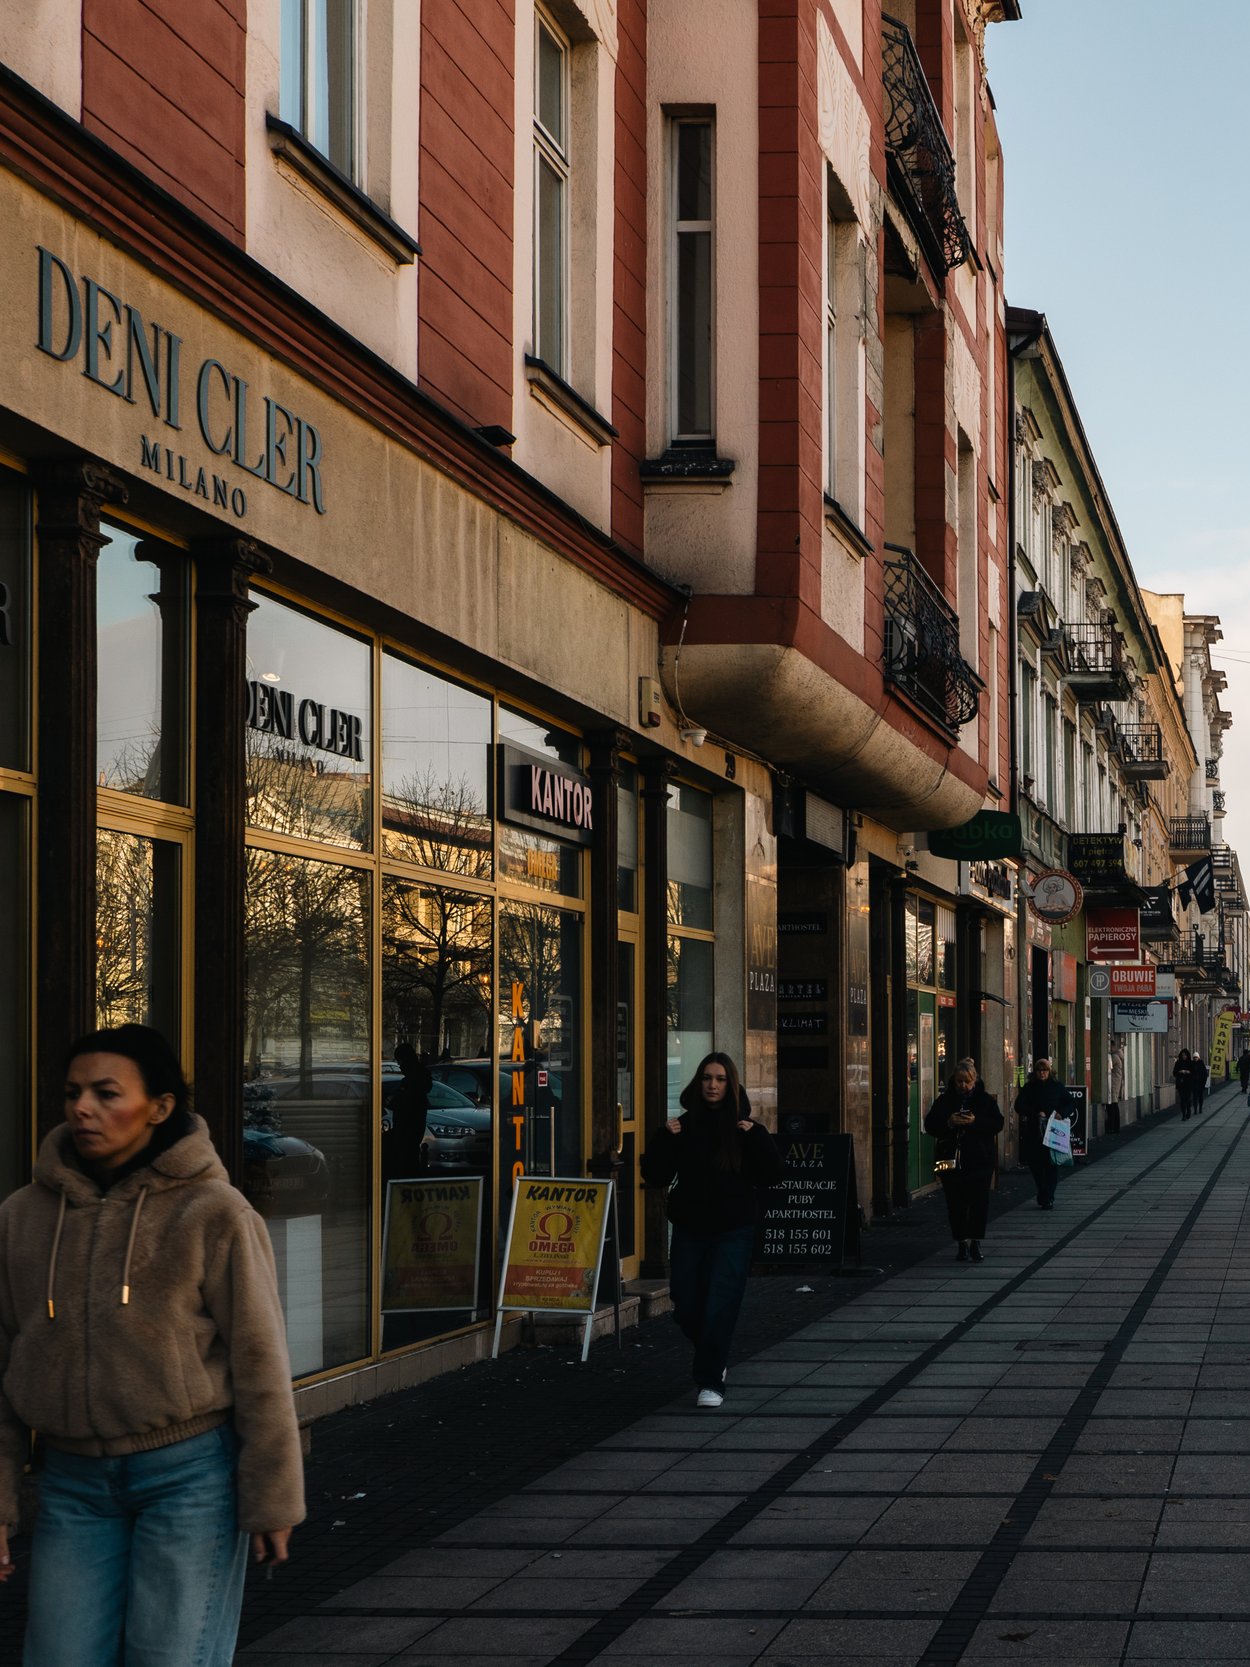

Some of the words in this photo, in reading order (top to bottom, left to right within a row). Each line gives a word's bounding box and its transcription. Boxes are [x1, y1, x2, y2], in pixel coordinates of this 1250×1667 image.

[35, 245, 184, 431] DENI
[196, 358, 327, 516] CLER
[140, 434, 248, 518] MILANO
[298, 698, 365, 762] CLER
[532, 764, 593, 830] KANTOR
[1072, 836, 1123, 845] DETEKTYW
[1088, 933, 1137, 941] PAPIEROSY
[749, 971, 775, 992] PLAZA
[1112, 970, 1154, 983] OBUWIE
[1114, 984, 1135, 992] TWOJA
[850, 987, 867, 1005] PLAZA
[782, 1018, 824, 1029] KLIMAT
[1212, 1023, 1229, 1070] KANTOR
[786, 1143, 824, 1159] AVE
[526, 1185, 597, 1203] KANTOR
[788, 1195, 815, 1204] PUBY
[765, 1210, 836, 1219] APARTHOSTEL
[765, 1229, 785, 1240] 518
[790, 1229, 808, 1240] 155
[812, 1229, 831, 1240] 601
[528, 1240, 576, 1253] OMEGA
[763, 1243, 784, 1254] 518
[788, 1243, 807, 1255] 155
[811, 1243, 832, 1255] 602
